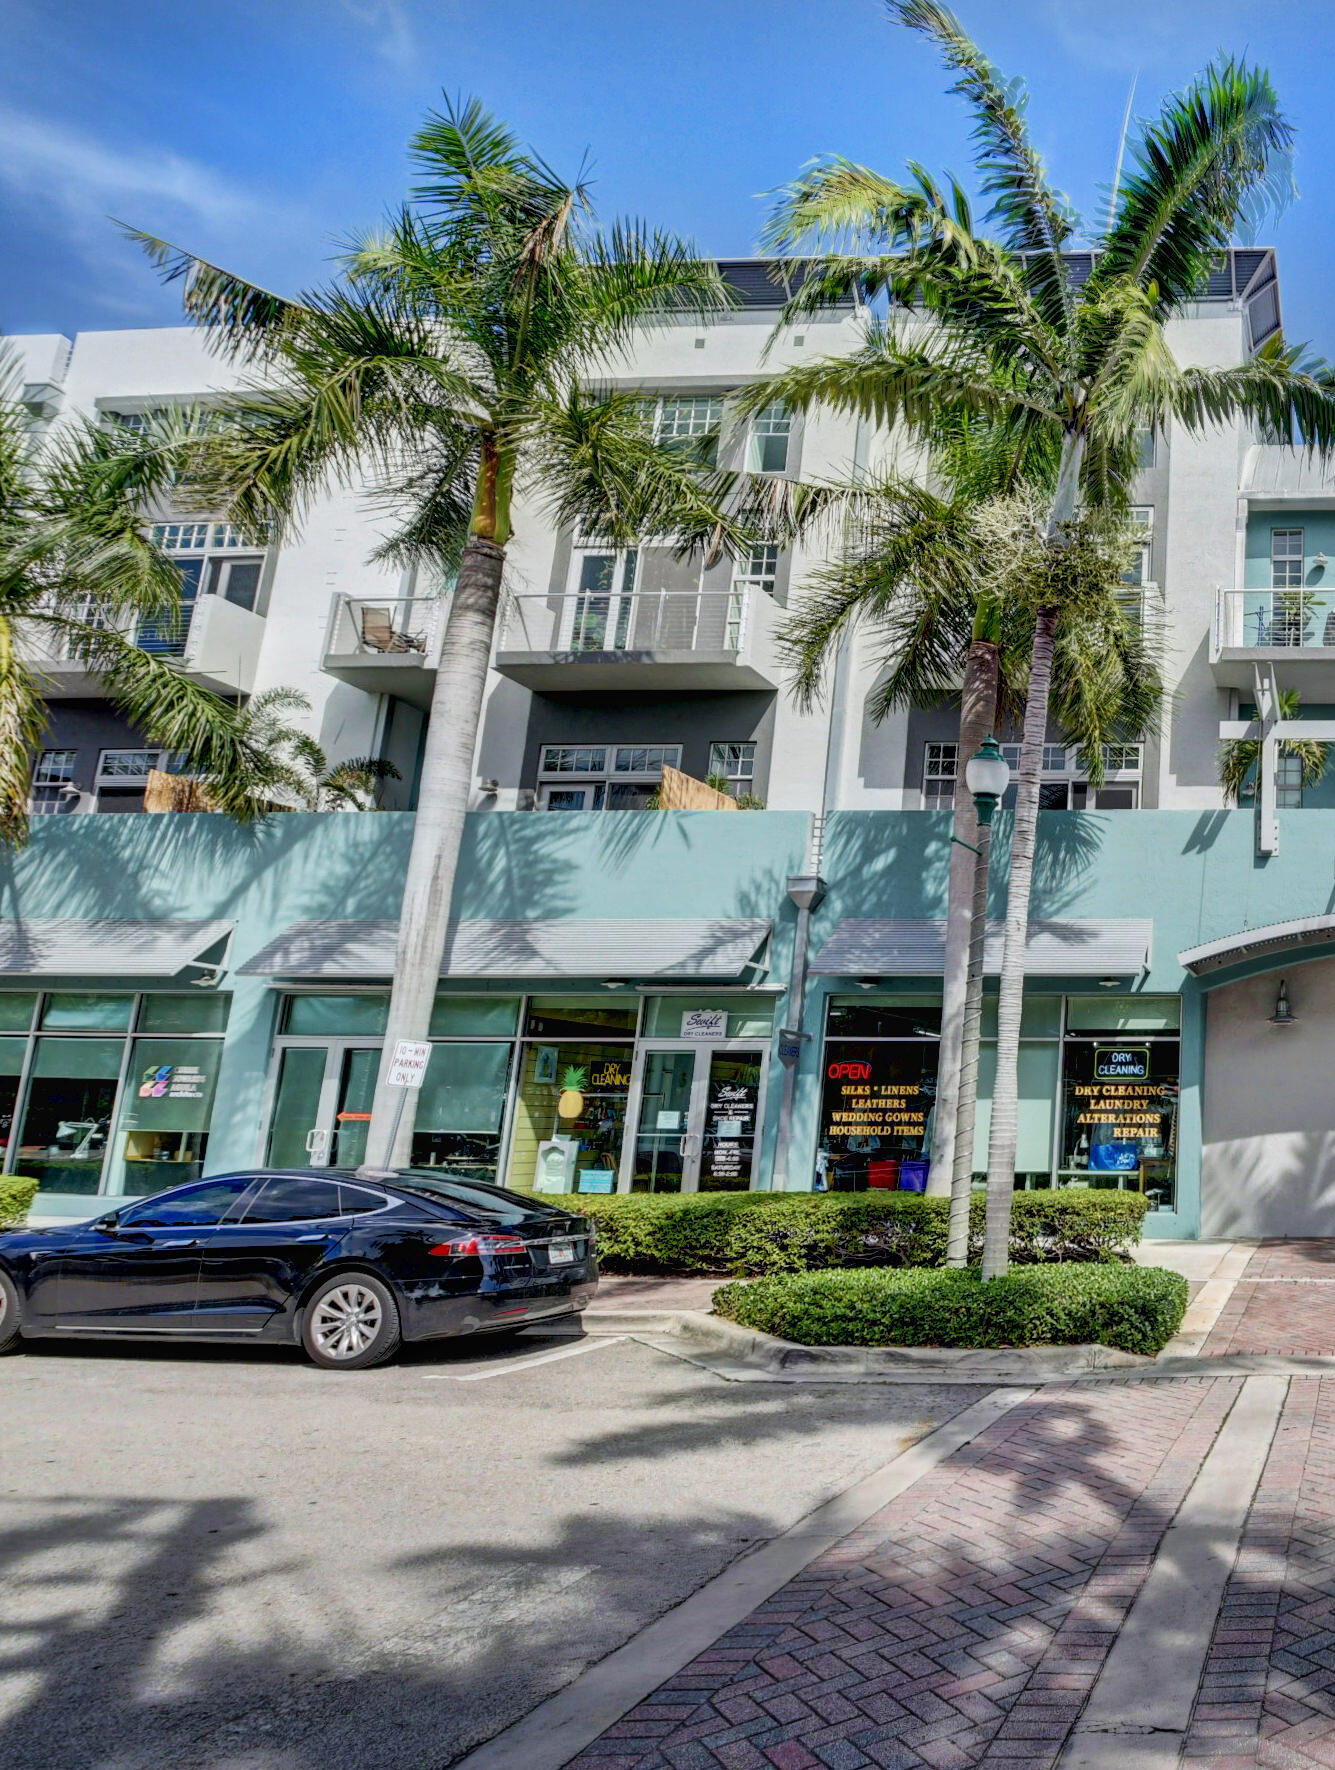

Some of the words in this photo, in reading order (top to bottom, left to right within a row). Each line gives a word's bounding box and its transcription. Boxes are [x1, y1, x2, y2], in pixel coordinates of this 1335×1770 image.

[687, 1014, 722, 1029] Swift
[1112, 1053, 1132, 1062] DRY
[394, 1059, 424, 1069] PARKING
[604, 1063, 621, 1074] DRY
[828, 1064, 870, 1080] OPEN
[1098, 1065, 1144, 1075] CLEANING
[396, 1073, 415, 1083] ONLY
[592, 1074, 631, 1086] CLEANING
[841, 1086, 870, 1095] SILKS
[881, 1086, 919, 1095] LINENS
[1075, 1086, 1099, 1096] DRY
[1102, 1086, 1165, 1096] CLEANING
[852, 1099, 906, 1108] LEATHERS
[1090, 1099, 1149, 1110] LAUNDRY
[832, 1113, 883, 1122] WEDDING
[885, 1113, 924, 1122] GOWNS
[1077, 1114, 1161, 1124] ALTERATIONS
[829, 1126, 891, 1135] HOUSEHOLD
[893, 1126, 924, 1135] ITEMS
[1113, 1128, 1159, 1138] REPAIR
